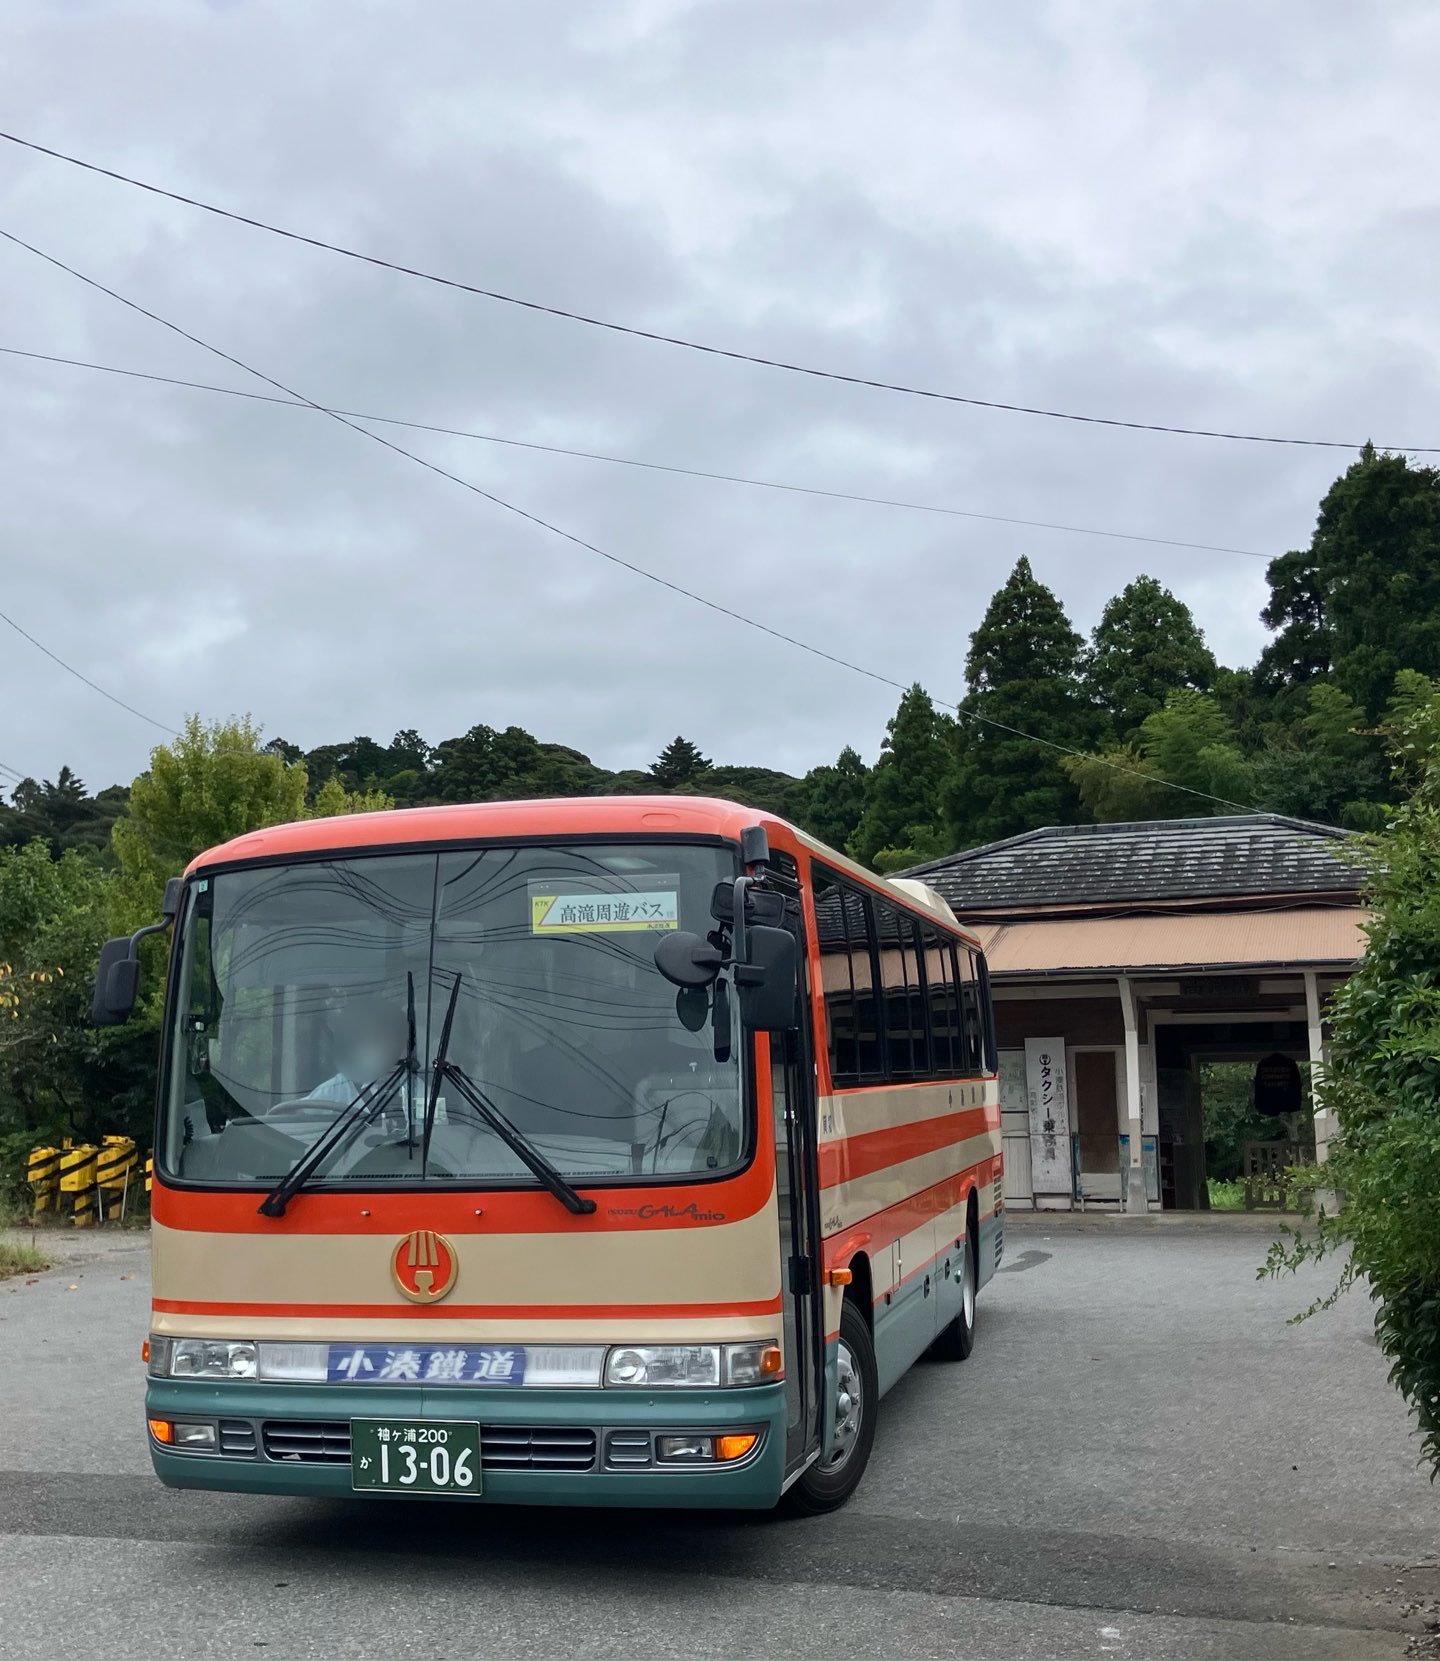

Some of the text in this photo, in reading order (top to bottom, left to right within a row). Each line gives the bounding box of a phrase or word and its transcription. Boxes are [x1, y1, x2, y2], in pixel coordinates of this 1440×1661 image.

[560, 902, 664, 923] 高滝周遊バス
[336, 1350, 515, 1380] 小湊鐵道
[360, 1444, 473, 1487] か 13-06
